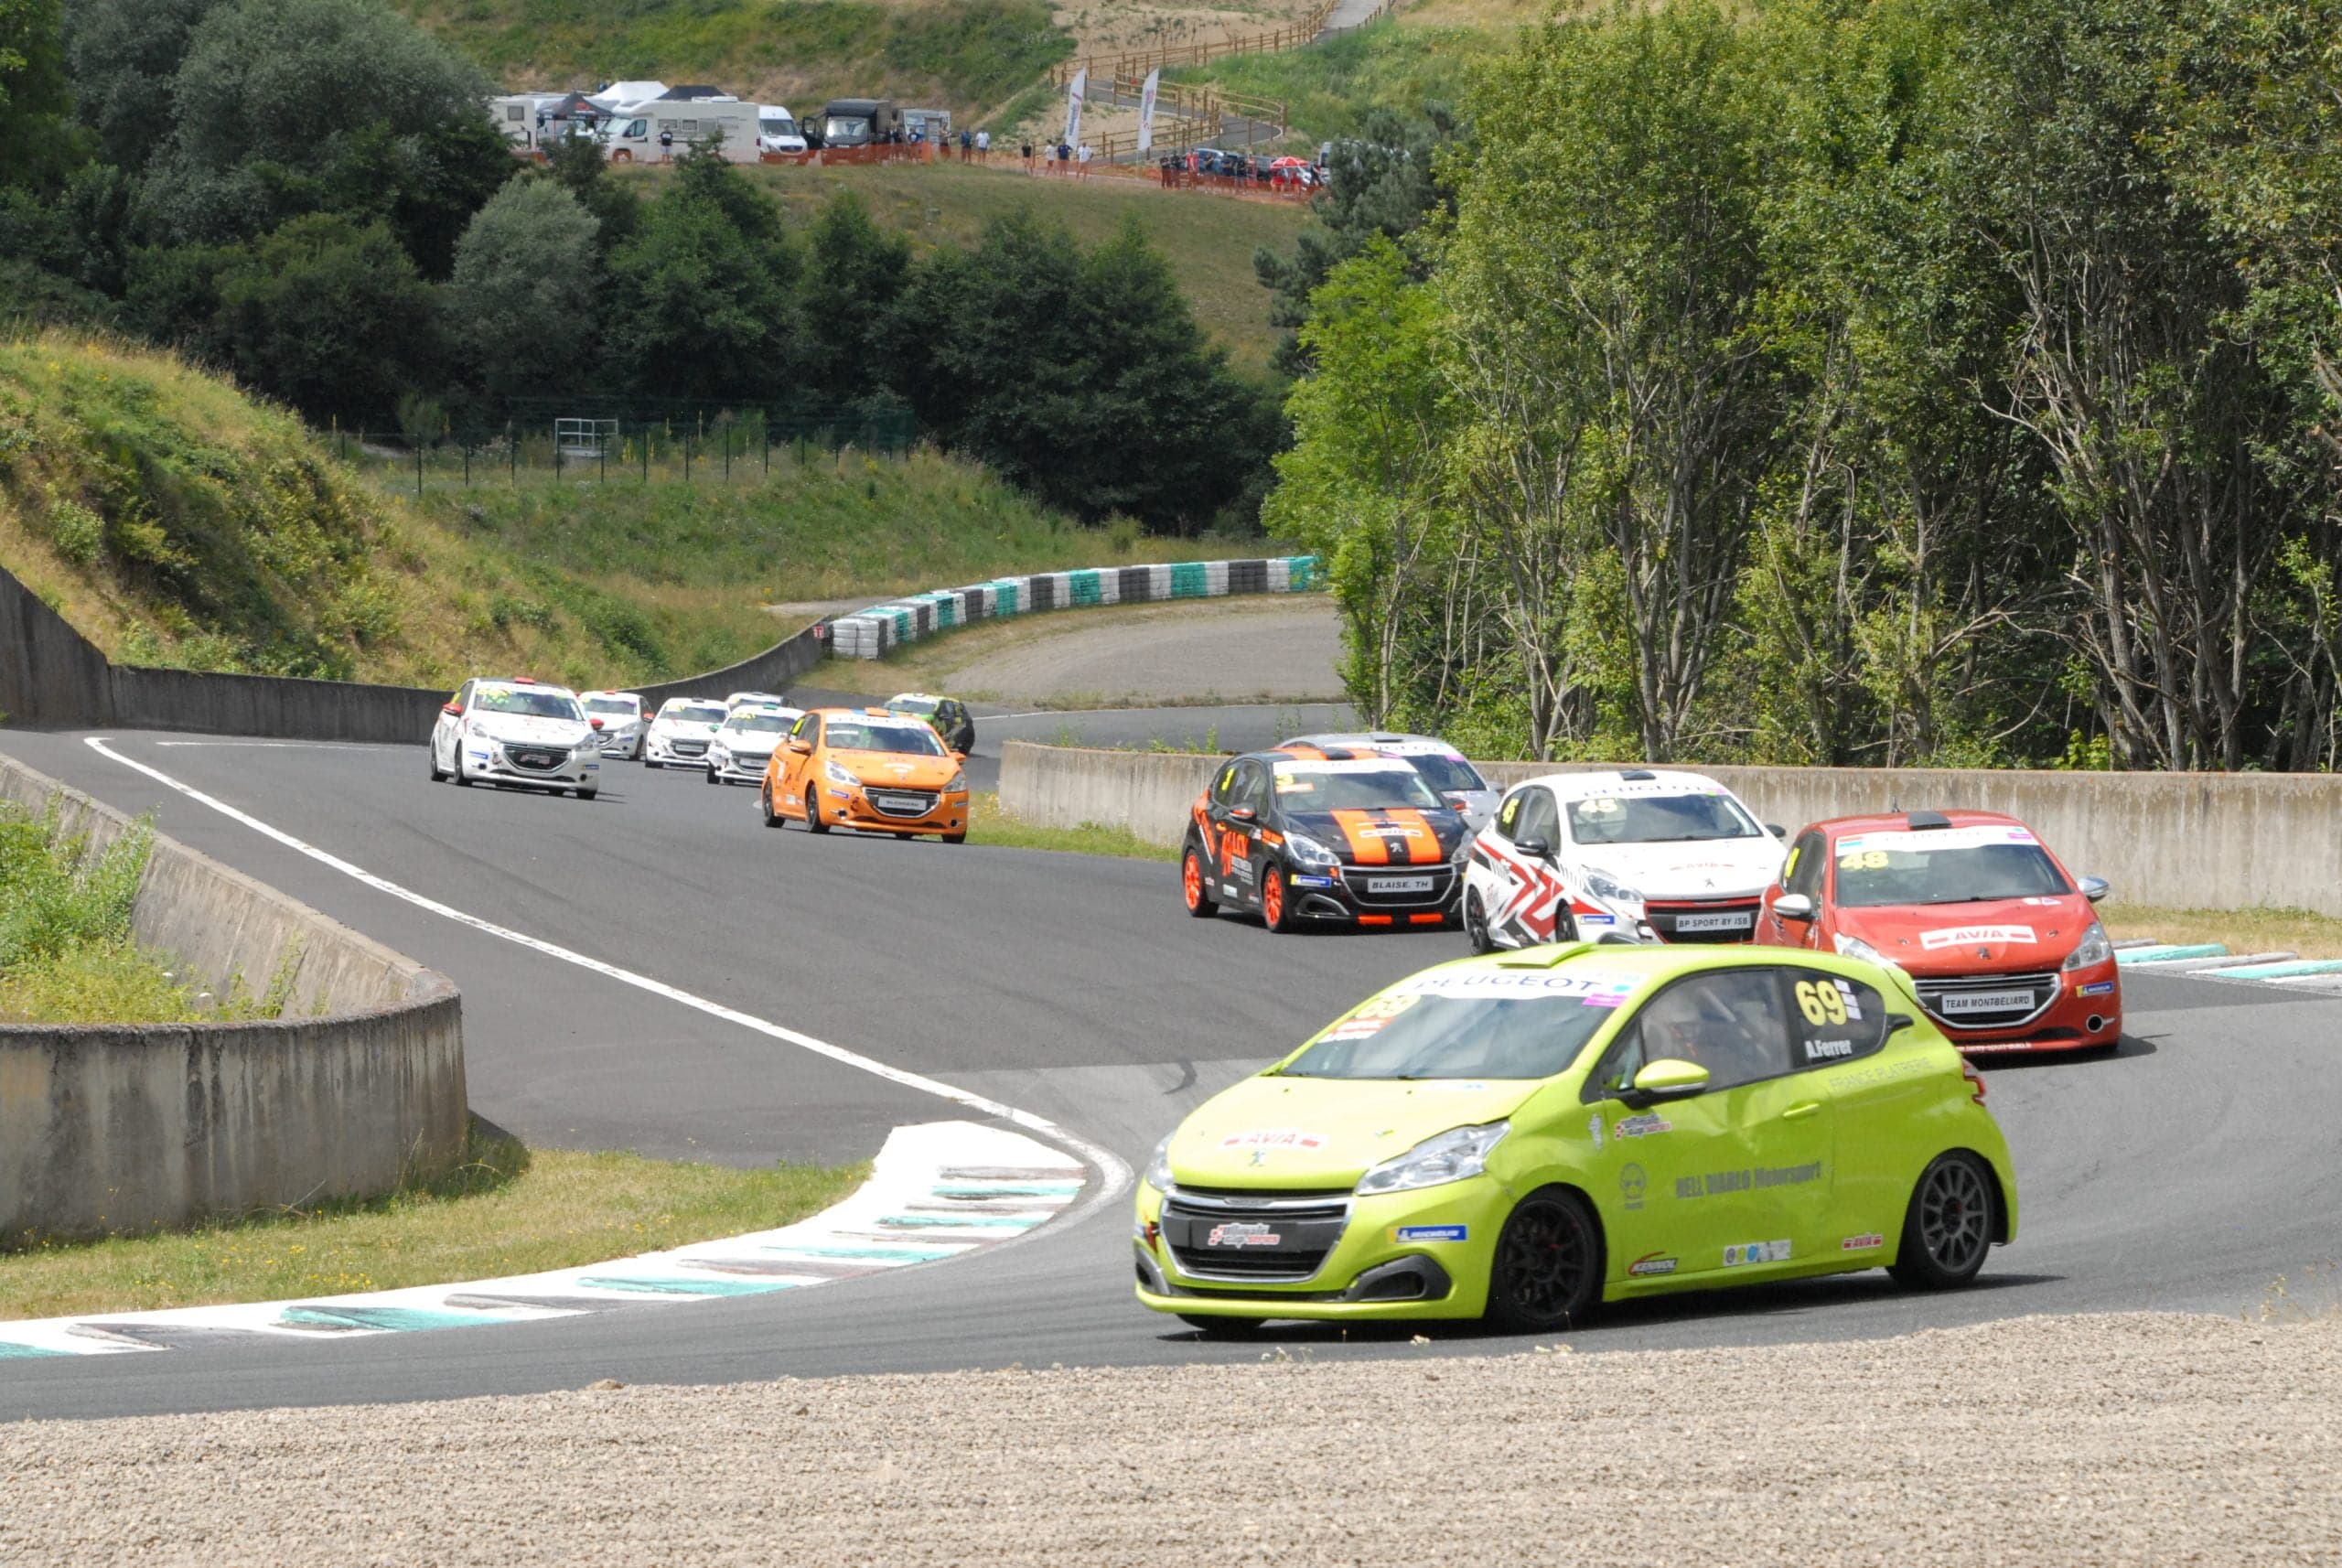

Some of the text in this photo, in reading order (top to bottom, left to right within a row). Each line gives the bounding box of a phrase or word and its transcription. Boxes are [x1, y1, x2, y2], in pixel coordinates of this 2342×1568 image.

[1578, 798, 1618, 813] 45
[1839, 851, 1888, 870] 48
[1679, 919, 1691, 929] BP
[1692, 918, 1719, 928] SPORT
[1722, 918, 1733, 927] BY
[1954, 929, 2004, 940] AVIA
[1415, 973, 1604, 993] PEUGEOT
[1795, 981, 1847, 1026] 69
[1946, 995, 2030, 1008] TEAM MONTBELIARD
[1805, 1040, 1853, 1058] A.Ferrer
